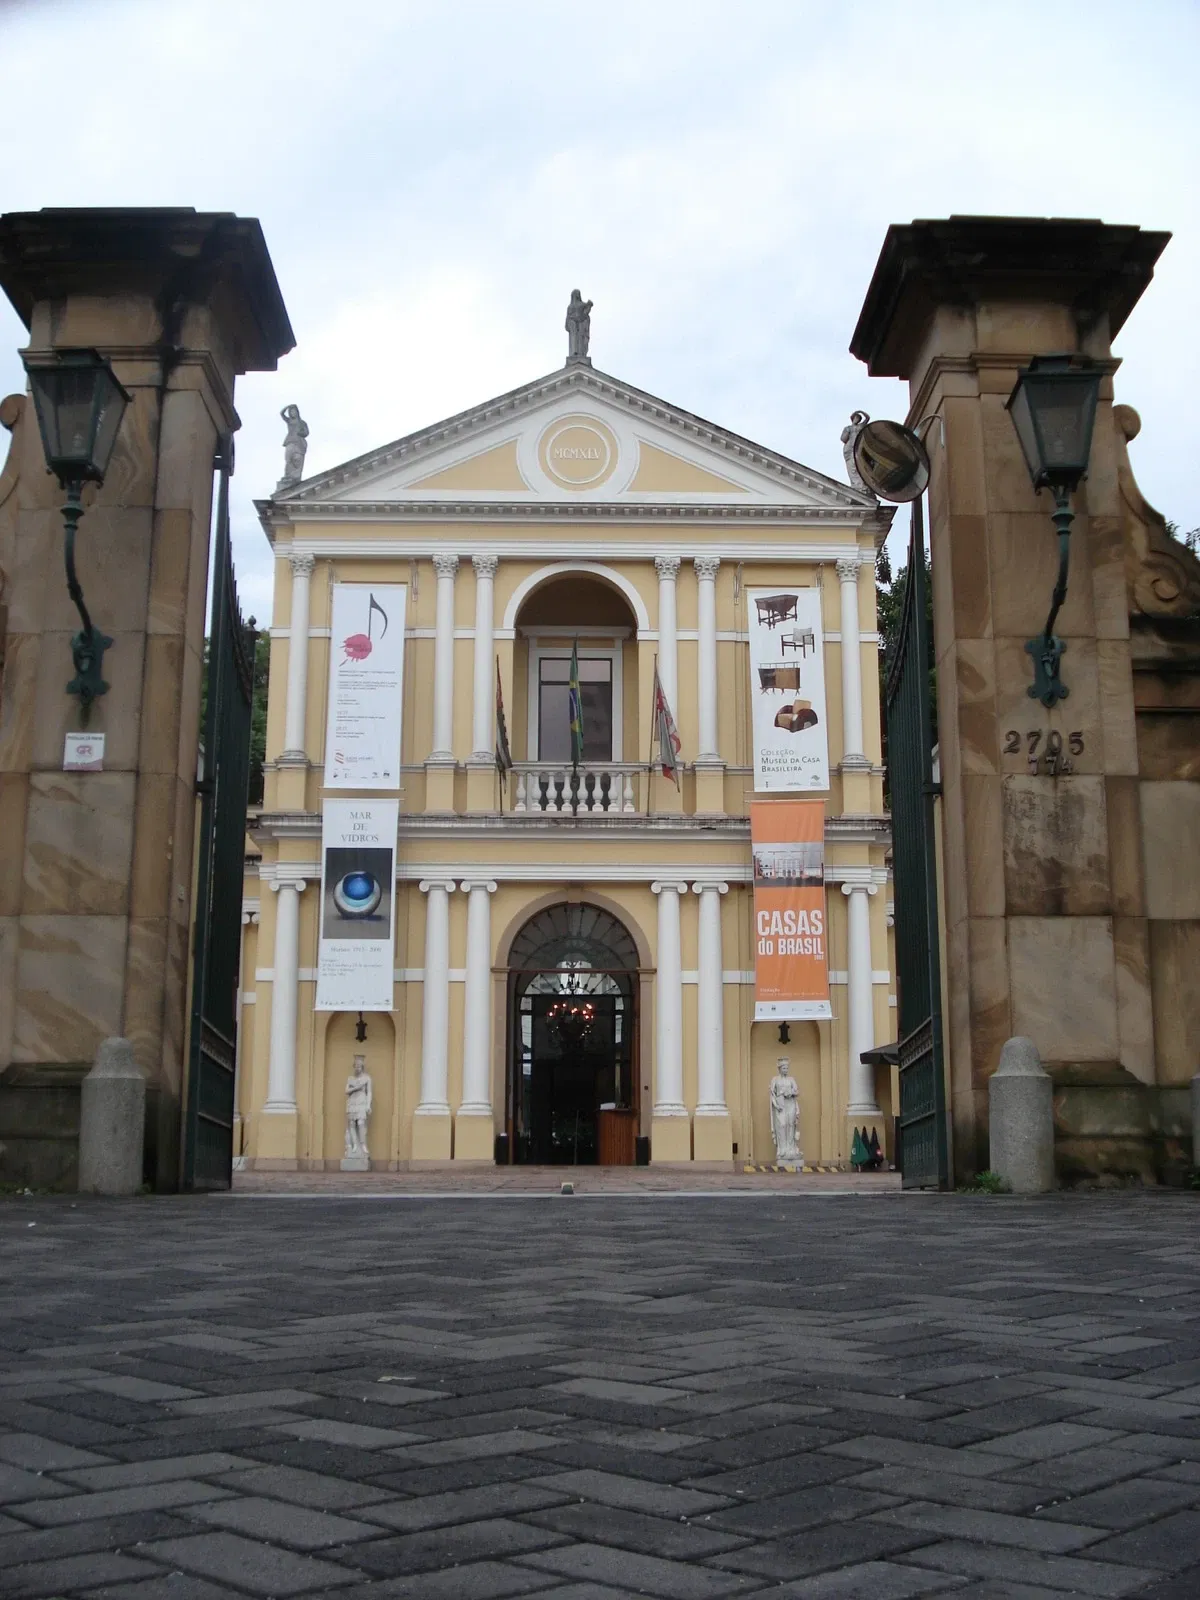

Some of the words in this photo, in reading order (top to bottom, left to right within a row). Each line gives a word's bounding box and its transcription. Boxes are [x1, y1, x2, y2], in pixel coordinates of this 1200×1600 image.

[554, 447, 602, 460] MCMXLV
[1003, 729, 1085, 756] 2705
[761, 757, 788, 765] MUSEU
[802, 756, 821, 764] CASA
[761, 765, 803, 773] BRASILEIRA
[349, 811, 372, 820] MAR
[352, 822, 369, 831] DE
[340, 833, 379, 843] VIDROS
[757, 909, 823, 936] CASAS
[758, 937, 774, 955] do
[778, 937, 825, 955] BRASIL
